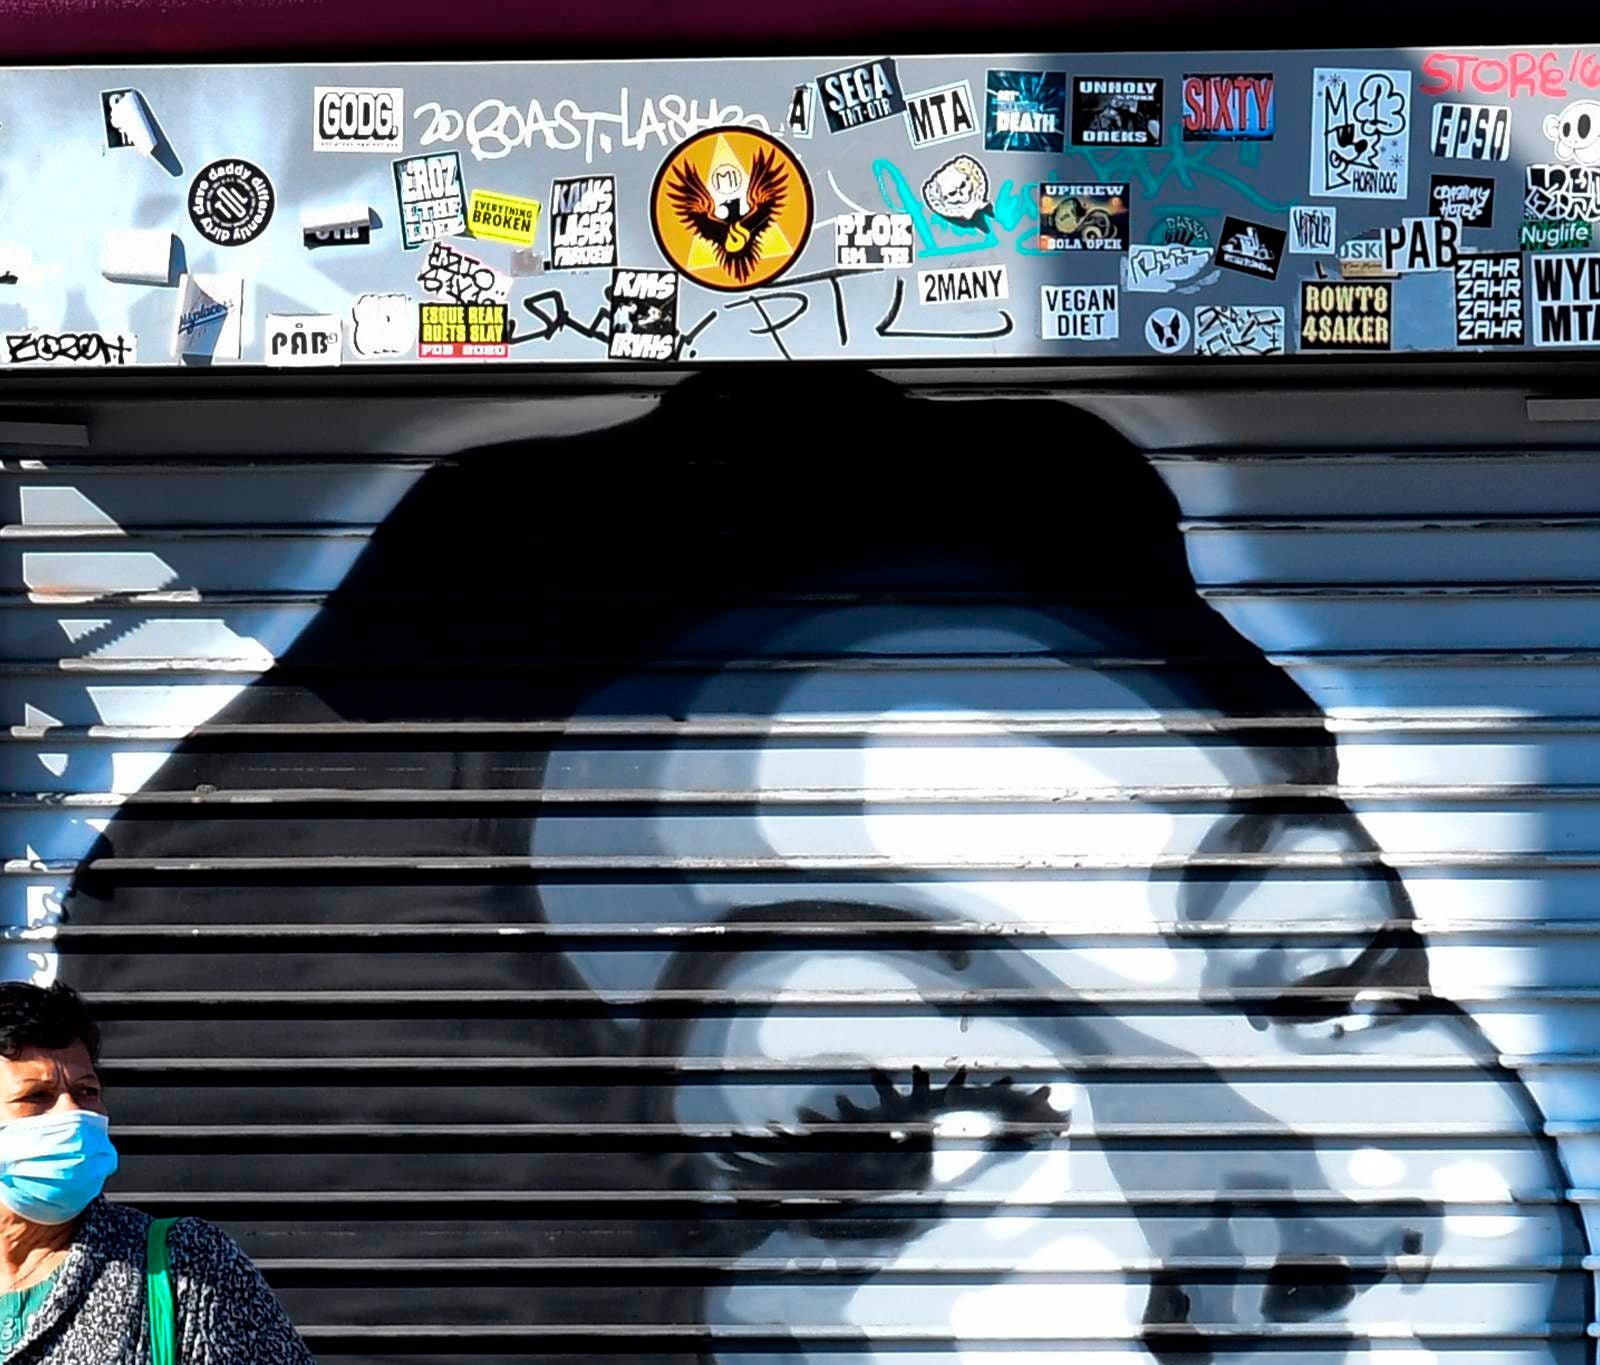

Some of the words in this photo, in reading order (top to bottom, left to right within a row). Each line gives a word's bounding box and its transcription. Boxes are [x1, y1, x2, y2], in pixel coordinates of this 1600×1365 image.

[824, 63, 893, 111] SEGA
[1079, 81, 1157, 94] UNHOLY
[1184, 77, 1272, 131] SIXTY
[908, 90, 972, 143] MTA
[997, 111, 1056, 133] DEATH
[1082, 130, 1148, 143] DREKS
[208, 163, 251, 180] daddy
[233, 177, 270, 240] differently
[1045, 185, 1124, 196] UPKREW
[472, 209, 531, 233] BROKEN
[837, 214, 913, 246] PLOK
[1521, 223, 1588, 247] Nuglife
[1456, 258, 1520, 279] ZAHR
[613, 271, 676, 299] KMS
[924, 269, 1002, 302] 2MANY
[1457, 278, 1521, 299] ZAHR
[1046, 288, 1115, 312] VEGAN
[1458, 299, 1521, 320] ZAHR
[1057, 314, 1105, 336] DIET
[1458, 319, 1522, 340] ZAHR
